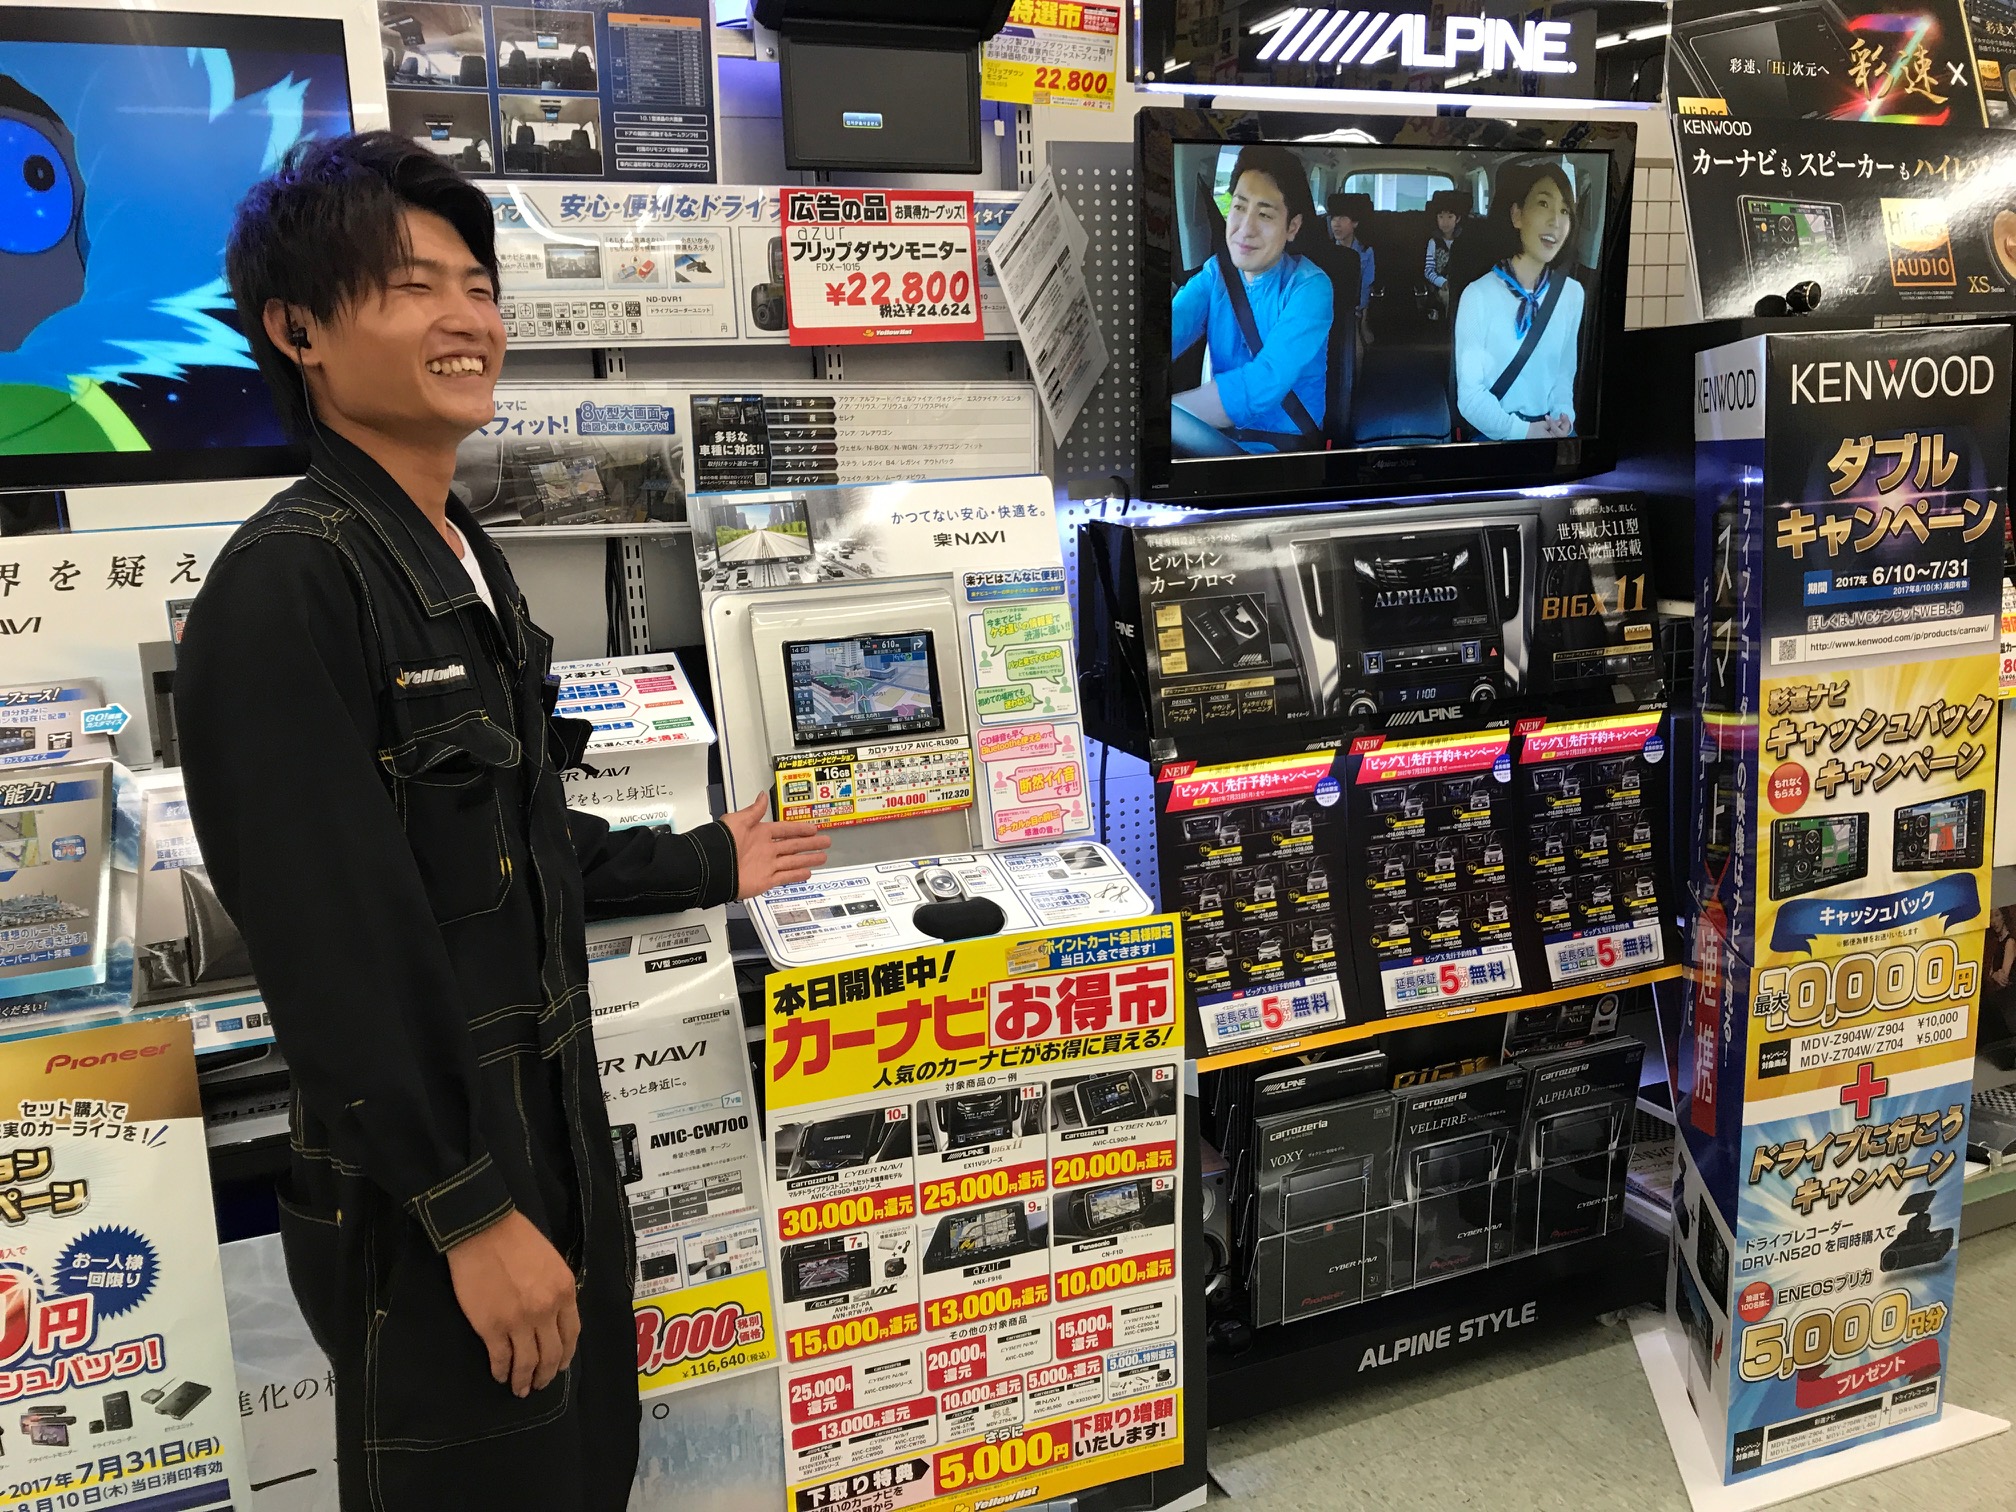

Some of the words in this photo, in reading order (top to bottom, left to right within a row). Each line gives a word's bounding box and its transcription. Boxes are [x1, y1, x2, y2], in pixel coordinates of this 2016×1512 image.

[987, 67, 1024, 77] フリップダウン
[1848, 38, 1949, 105] 彩速
[1683, 119, 1751, 136] KENWOOD
[789, 193, 888, 222] 広告の品
[895, 205, 965, 220] お買得カーグッズ!
[797, 227, 845, 240] azur
[790, 241, 968, 261] フリップダウンモニター
[1896, 256, 1950, 276] AUDIO
[1967, 275, 1990, 294] XS
[876, 328, 913, 336] YellowHat
[1697, 369, 1757, 414] KENWOOD
[1791, 355, 1995, 405] KENWOOD
[581, 421, 670, 432] 地図も映像も見やすい!
[714, 431, 748, 443] 多彩な
[699, 444, 764, 456] 車種に対応!!
[1827, 433, 1959, 495] ダブル
[786, 475, 819, 483] ダイハツ
[891, 503, 1046, 525] かつてない安心・快適を。
[933, 530, 1006, 548] 楽NAVI
[1556, 518, 1640, 541] 世界最大11型
[1776, 498, 1998, 559] キャンペーン
[1148, 551, 1223, 572] ビルトイン
[1542, 538, 1643, 563] WXGA液晶搭載
[965, 568, 1064, 587] 楽ナビはこんなに便利!
[1150, 573, 1237, 595] カーアロマ
[1807, 581, 1828, 594] 期間
[1836, 575, 1868, 588] 2017年
[1374, 585, 1459, 608] ALPHARD
[1613, 573, 1647, 613] 11
[986, 612, 1022, 628] 今までとは
[1807, 602, 1964, 631] 詳しくはJVCケンウッドWEBより
[1810, 623, 1990, 651] http://www.kenwood.com/jp/products/carnavi/
[977, 689, 1026, 708] 初めての場所でも
[1003, 696, 1033, 710] 迷わない!
[1244, 689, 1267, 697] CAMERA
[1767, 680, 1851, 716] 彩速ナビ
[1411, 706, 1463, 726] ALPINE
[1518, 720, 1541, 732] NEW
[1766, 694, 1996, 760] キャッシュバック
[868, 743, 914, 755] カロッツェリア
[916, 738, 959, 749] AVIC-RL900
[980, 728, 1024, 746] CD録音も早く
[981, 729, 1053, 755] Bluetoothも使えるので
[1355, 739, 1380, 751] NEW
[1528, 728, 1653, 751] 「ビッグX」先行予約キャンペーン
[1365, 745, 1503, 771] 「ビッグX」先行予約キャンペーン
[823, 766, 850, 780] 16GB
[1019, 766, 1076, 795] 断然イイ音
[1164, 765, 1190, 778] NEW
[1774, 776, 1803, 788] もれなく
[1815, 742, 1987, 800] キャンペーン
[819, 785, 831, 799] 8
[1176, 769, 1325, 799] 「ビッグX」先行予約キャンペーン
[1774, 787, 1803, 799] もらえる
[619, 810, 669, 824] AVIC-CW700
[1819, 890, 1935, 927] キャッシュバック
[1043, 923, 1173, 955] ポイントカード会員様限定
[1558, 946, 1595, 964] 延長保証
[1596, 936, 1616, 969] 5
[1623, 932, 1653, 957] 無料
[650, 959, 671, 971] 7V型
[671, 955, 703, 967] 200mmワイド
[1060, 943, 1157, 967] 当日入会できます!
[772, 949, 957, 1016] 本日開催中!
[1395, 973, 1437, 991] 延長保証
[1438, 962, 1460, 995] 5
[1469, 959, 1506, 984] 無料
[1759, 940, 1978, 1033] 10,000円
[1215, 1006, 1260, 1026] 延長保証
[1261, 996, 1283, 1030] 5
[1292, 991, 1329, 1018] 無料
[1753, 991, 1789, 1016] 最大
[682, 1008, 730, 1025] carrozzeria
[772, 988, 987, 1082] カーナビ
[994, 966, 1170, 1042] お得市
[1801, 1022, 1905, 1053] MDV-Z904W/Z904
[1917, 1010, 1960, 1029] ¥10,000
[44, 1043, 171, 1075] Pioneer
[634, 1039, 708, 1071] NAVI
[871, 1026, 1175, 1089] 人気のカーナビがお得に買える!
[1760, 1049, 1788, 1061] キャンペーン
[1800, 1037, 1904, 1068] MDV-Z704W/Z704
[1916, 1027, 1953, 1045] ¥5,000
[1540, 1063, 1590, 1082] carrozzeria
[1760, 1057, 1788, 1071] 対象商品
[944, 1072, 1018, 1092] 対象商品の一例
[1277, 1077, 1307, 1090] ALPINE
[1412, 1091, 1468, 1111] carrozzeria
[1535, 1083, 1591, 1107] ALPHARD
[20, 1099, 128, 1120] セット購入で
[650, 1114, 749, 1150] AVIC-CW700
[1064, 1127, 1105, 1140] carrozzeria
[1113, 1122, 1144, 1132] CYBER
[1145, 1119, 1168, 1128] NAVI
[1269, 1119, 1328, 1142] carrozzeria
[1409, 1112, 1468, 1135] VELLFIRE
[709, 1141, 732, 1151] オープン
[1092, 1134, 1137, 1147] AVIC-CL900-M
[1749, 1104, 1966, 1184] ドライブに行こう
[1053, 1148, 1173, 1185] 20,000円還元
[1269, 1149, 1304, 1168] VOXY
[790, 1175, 835, 1189] carrozzeria
[844, 1167, 877, 1178] CYBER
[880, 1162, 904, 1172] NAVI
[1792, 1150, 1956, 1215] キャンペーン
[810, 1183, 882, 1201] AVIC-CE900-Mシリーズ
[924, 1169, 1046, 1211] 25,000円還元
[782, 1195, 914, 1237] 30,000円還元
[1079, 1239, 1111, 1251] Panasonic
[1456, 1228, 1484, 1240] CYBER
[1744, 1220, 1855, 1253] ドライブレコーダー
[1741, 1244, 1821, 1271] DRV-N520
[1824, 1224, 1897, 1253] を同時購入で
[71, 1251, 144, 1273] お一人様
[972, 1262, 1001, 1274] azur
[1328, 1259, 1358, 1274] CYBER
[1429, 1255, 1471, 1270] Pioneer
[69, 1271, 141, 1288] 一回限り
[1056, 1257, 1172, 1298] 10,000円還元
[1777, 1270, 1874, 1305] ENEOSプリカ
[834, 1300, 871, 1314] AVN-R7-PA
[927, 1283, 1049, 1327] 13,000円還元
[1300, 1288, 1345, 1308] Pioneer
[737, 1316, 760, 1329] 税別
[949, 1314, 1028, 1340] その他の対象商品
[1057, 1314, 1113, 1340] 15,000円
[738, 1328, 762, 1342] 価格
[789, 1313, 918, 1358] 15,000円還元
[1071, 1334, 1099, 1352] 還元
[1358, 1325, 1451, 1373] ALPINE
[1458, 1301, 1536, 1342] STYLE
[1740, 1289, 1947, 1381] 5,000円分
[929, 1342, 986, 1371] 20,000円
[943, 1364, 972, 1384] 還元
[1028, 1358, 1101, 1389] 5,000円還元
[1836, 1357, 1906, 1395] プレゼント
[791, 1375, 852, 1404] 25,000円
[942, 1378, 1021, 1411] 10,000円還元
[807, 1396, 838, 1416] 還元
[1073, 1396, 1174, 1439] 下取り増額
[818, 1406, 911, 1442] 13,000円還元
[984, 1423, 1024, 1444] さらに
[1074, 1421, 1167, 1457] いたします!
[939, 1431, 1069, 1490] 5,000円
[131, 1461, 224, 1494] 当日消印有効
[806, 1462, 914, 1508] 下取り特典
[973, 1486, 1039, 1510] YellowHat
